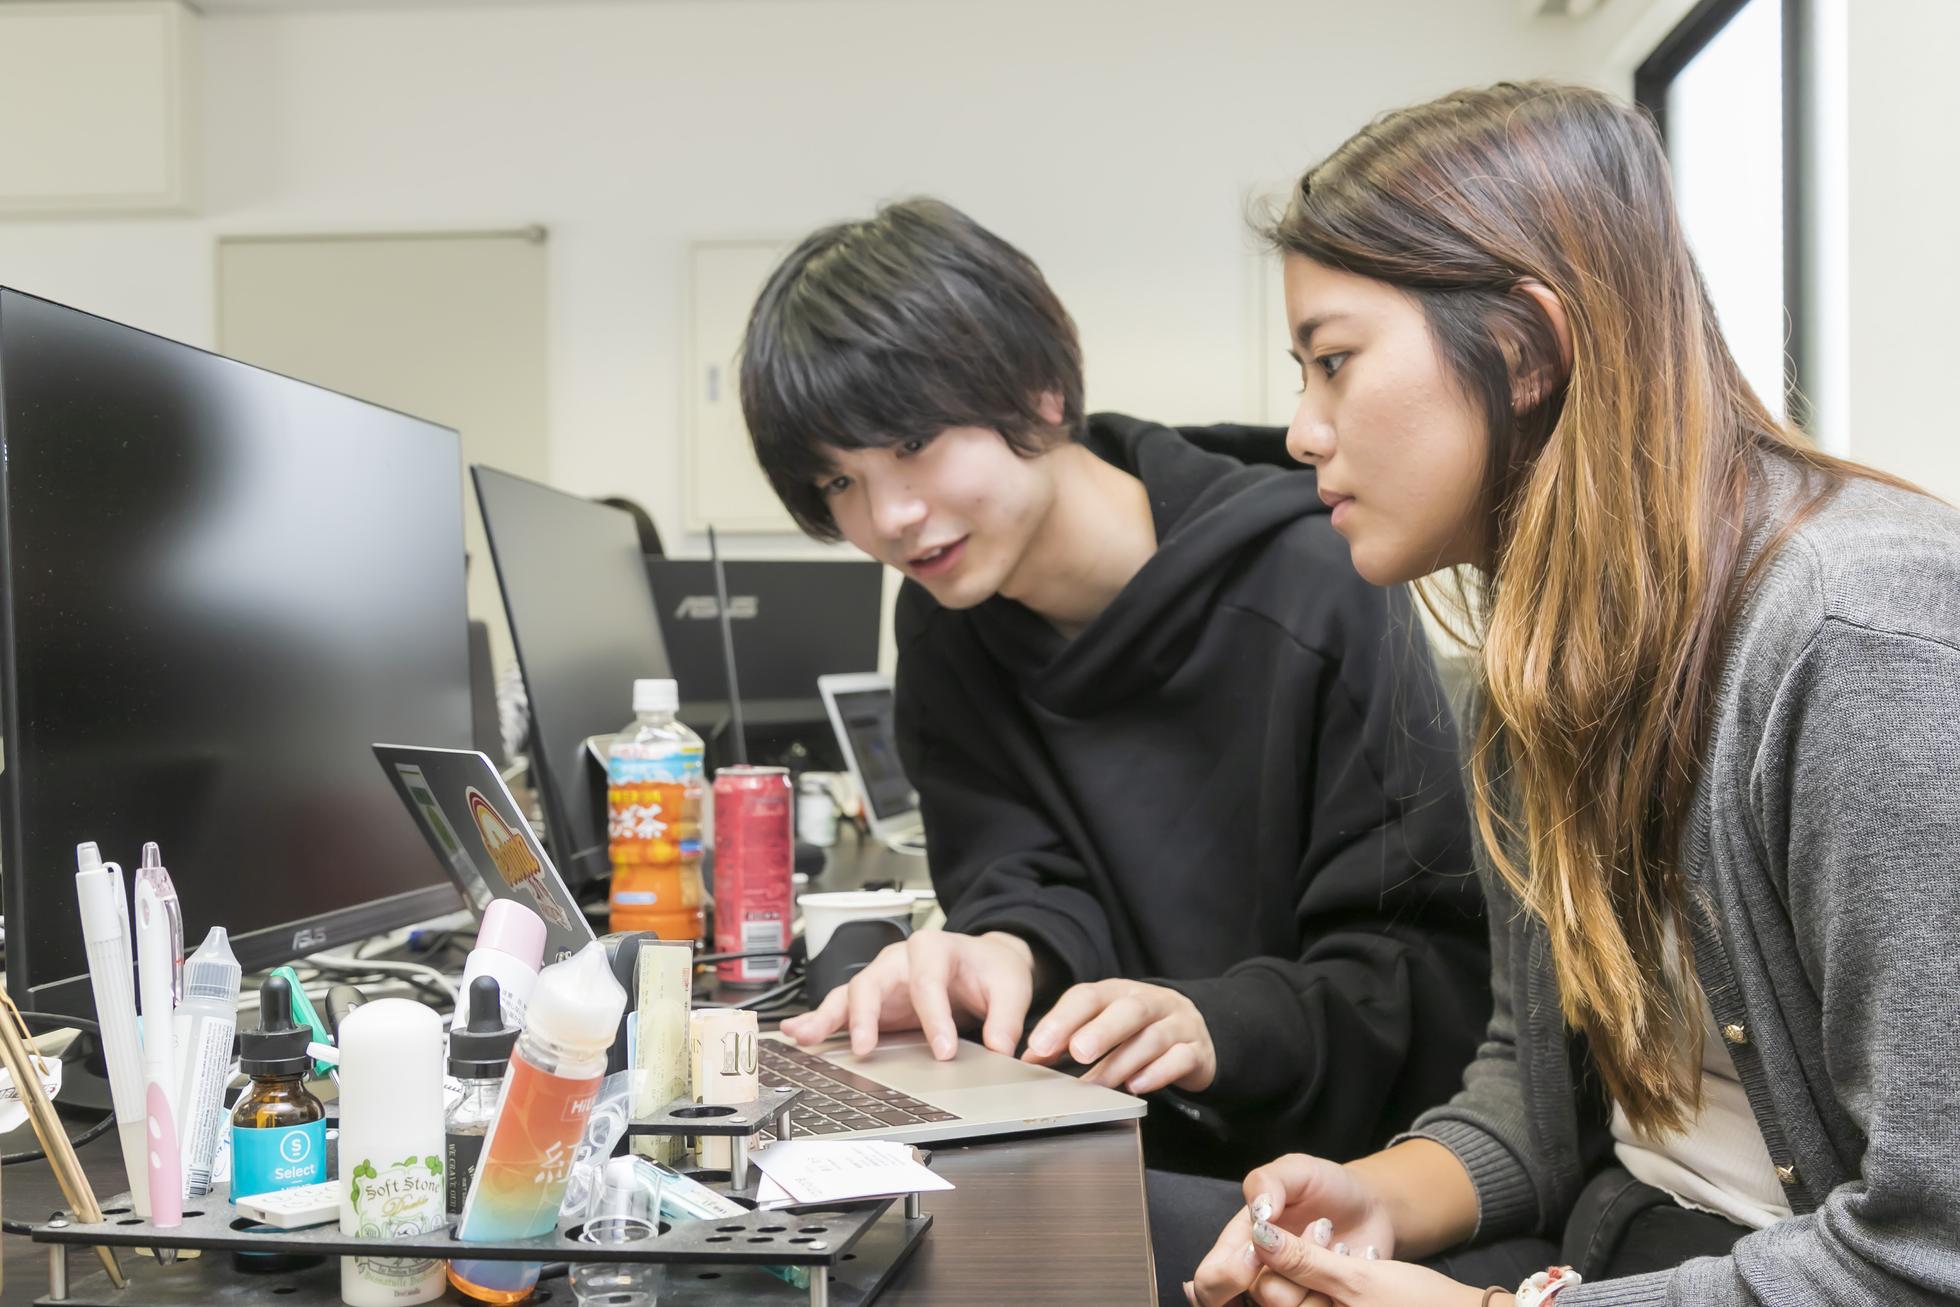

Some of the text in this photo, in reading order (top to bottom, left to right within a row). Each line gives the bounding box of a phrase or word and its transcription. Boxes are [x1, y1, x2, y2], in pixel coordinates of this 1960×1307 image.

[720, 1031, 758, 1077] 10
[275, 1164, 316, 1180] Select
[365, 1178, 399, 1201] Soft
[402, 1176, 440, 1194] Stone
